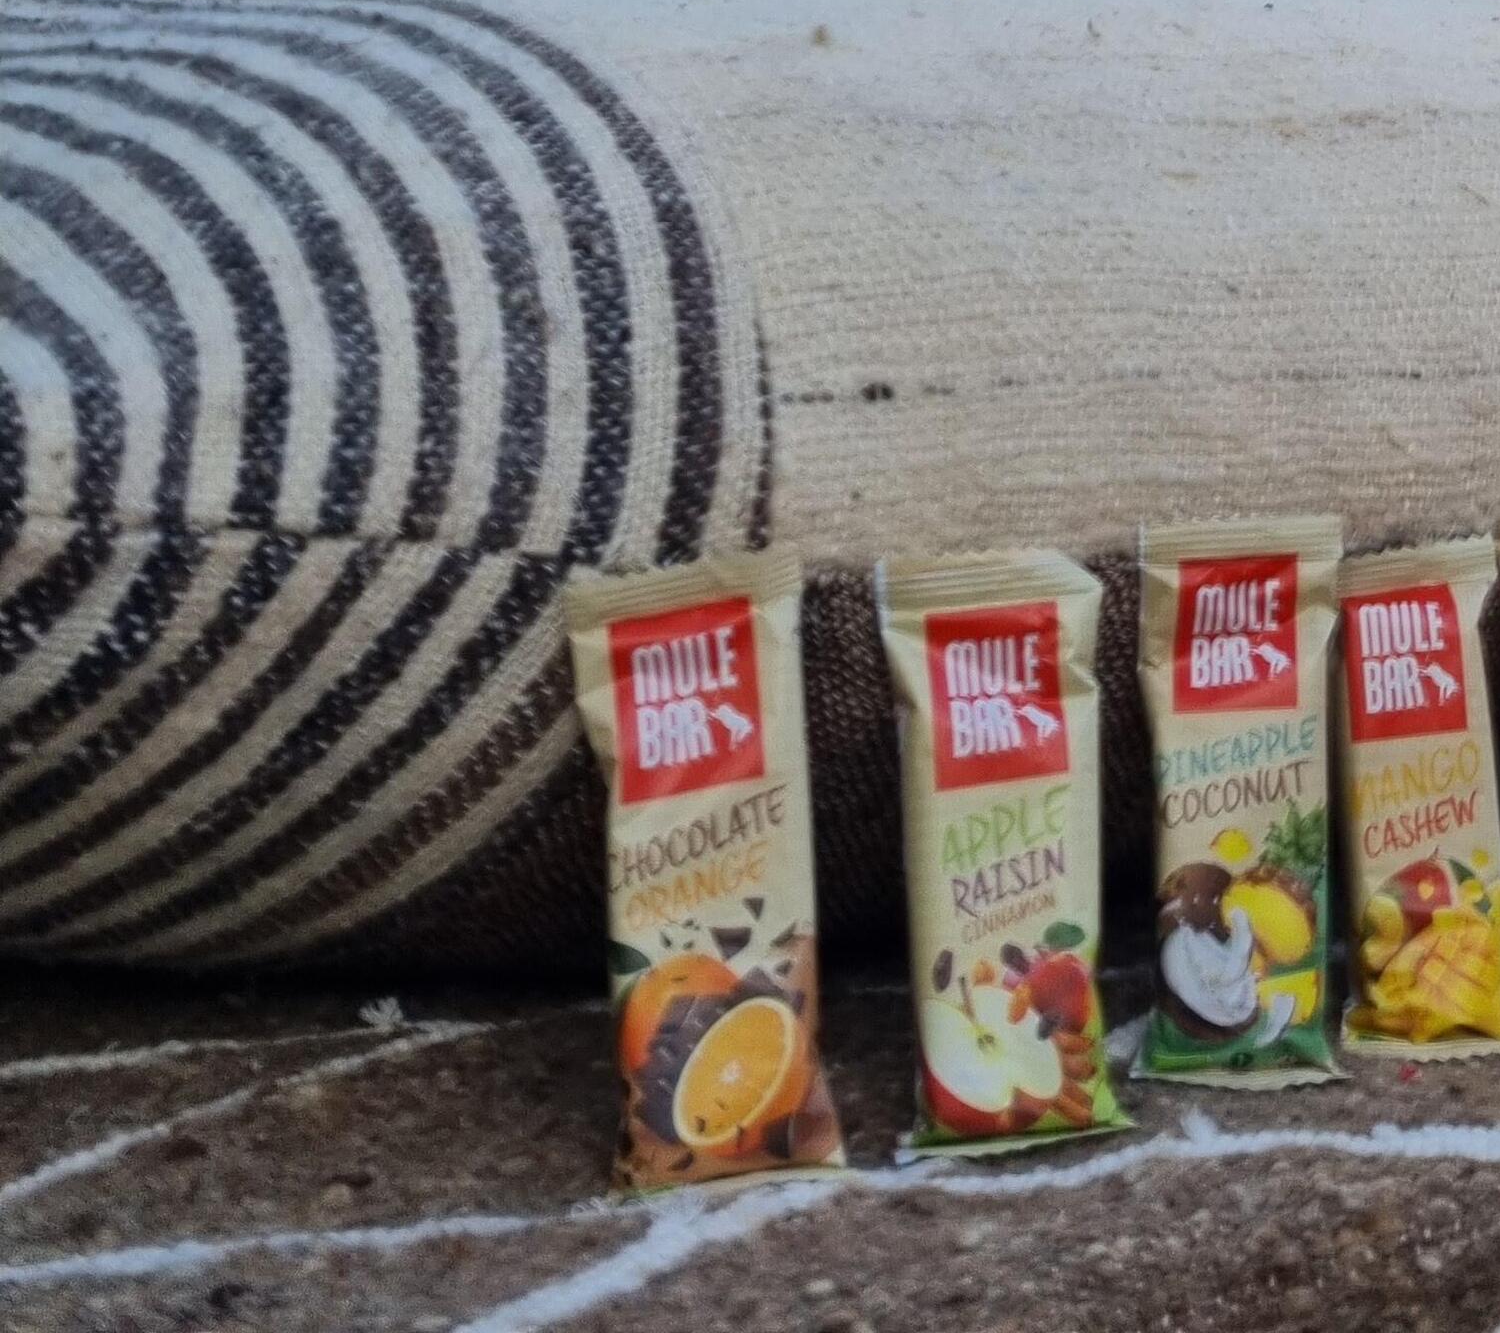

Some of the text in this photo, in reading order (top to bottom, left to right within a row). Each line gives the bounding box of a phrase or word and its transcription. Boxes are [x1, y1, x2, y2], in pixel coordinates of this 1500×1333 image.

[1194, 577, 1280, 634] MULE
[1358, 600, 1444, 658] MULE
[631, 626, 739, 706] MULE
[945, 634, 1041, 698] MULE
[1190, 635, 1256, 688] BAR
[1363, 656, 1426, 714] BAR
[636, 698, 715, 770] BAR
[950, 695, 1023, 758] BAR
[1155, 715, 1318, 784] PINEAPPLE
[1163, 757, 1312, 829] COCONUT
[1351, 740, 1481, 822] MANGO
[940, 784, 1072, 872] APPLE
[1364, 788, 1479, 859] CASHEW
[624, 838, 770, 931] ORANGE
[951, 836, 1066, 917] RAISIN
